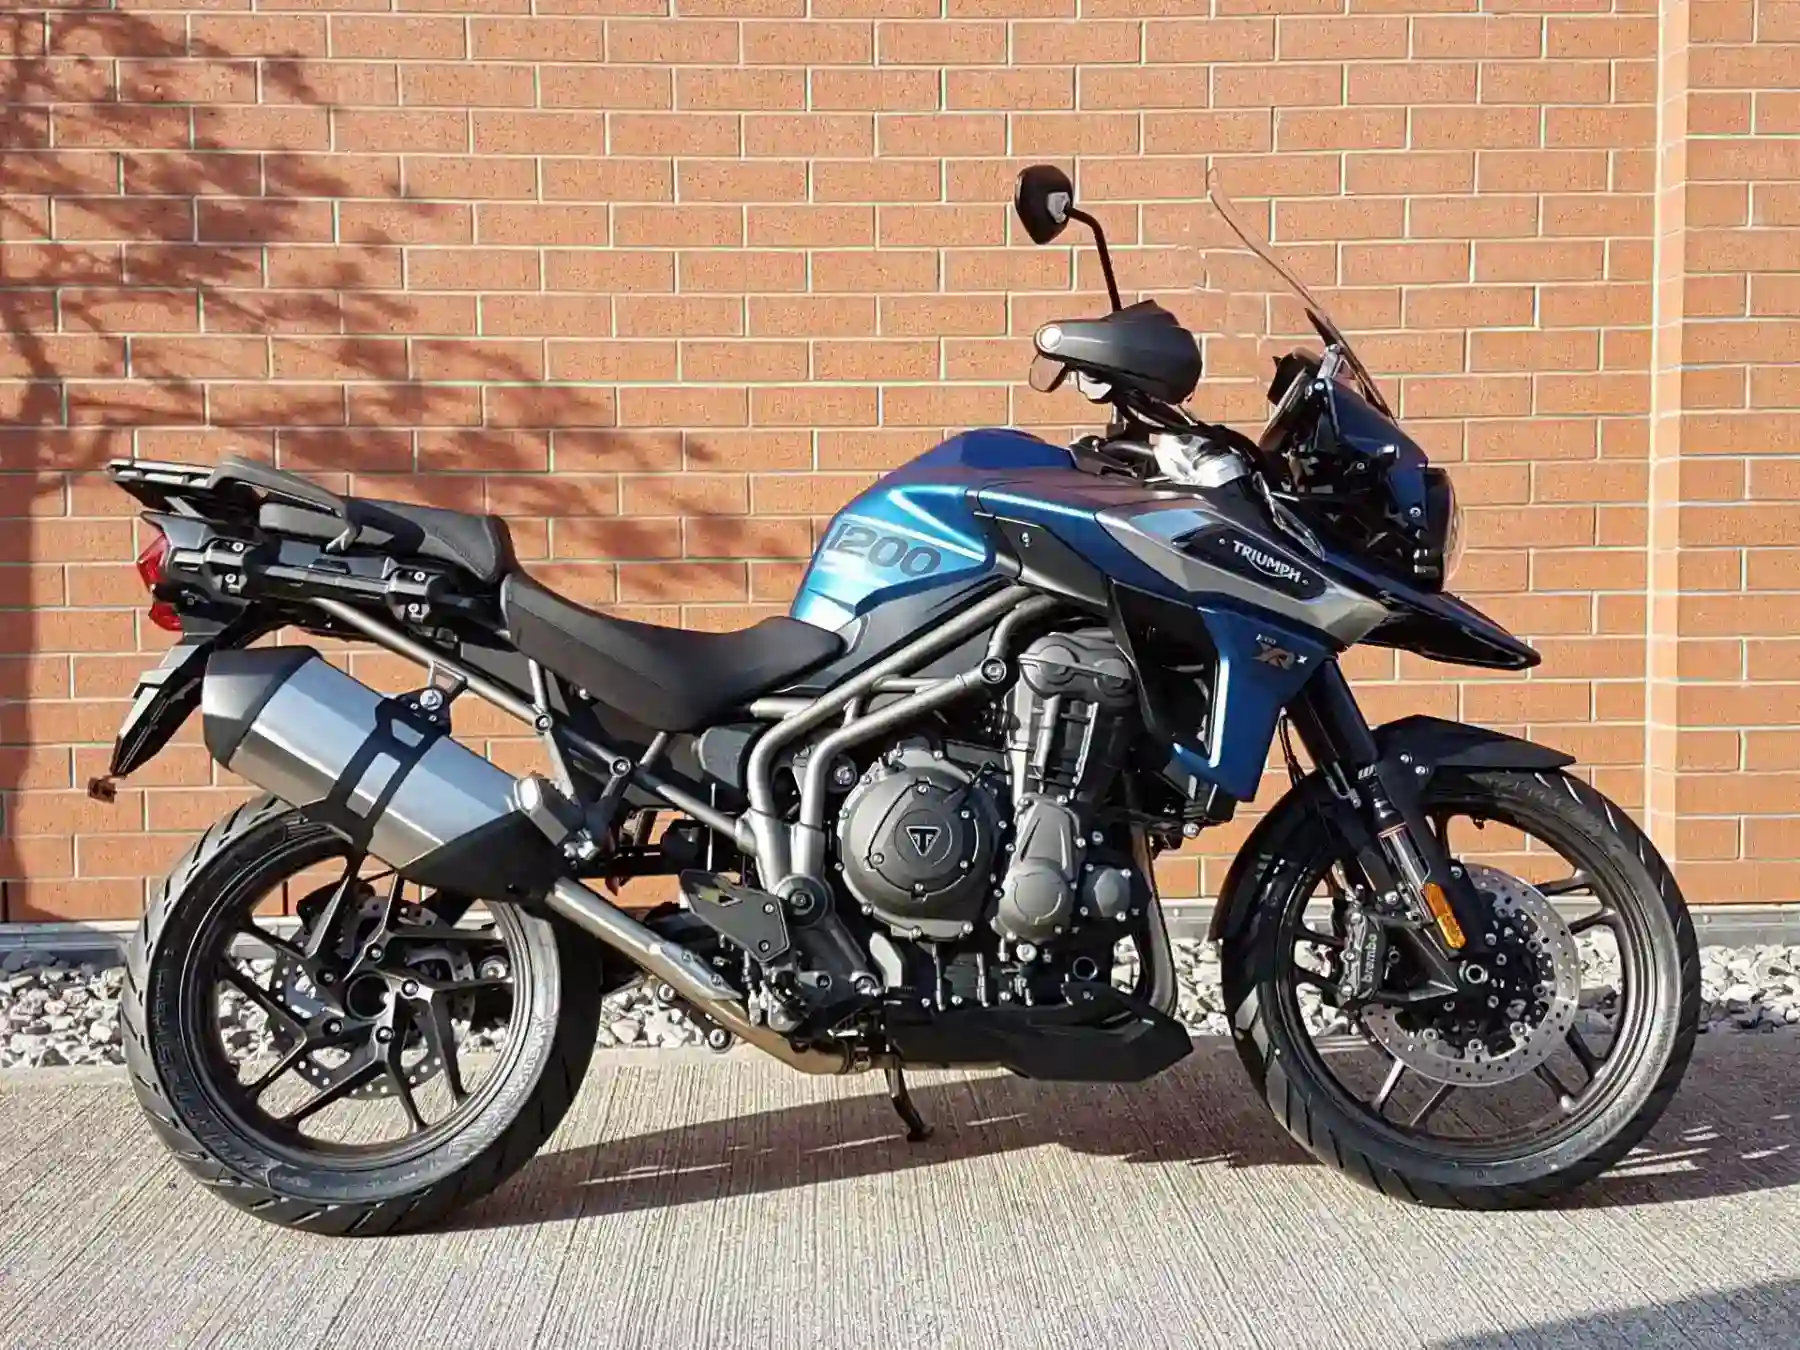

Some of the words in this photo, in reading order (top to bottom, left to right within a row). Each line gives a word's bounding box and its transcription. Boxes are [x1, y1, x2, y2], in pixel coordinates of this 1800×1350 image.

[826, 523, 941, 577] 1200
[1232, 540, 1302, 583] TRIUMPH
[1361, 933, 1377, 983] brembo
